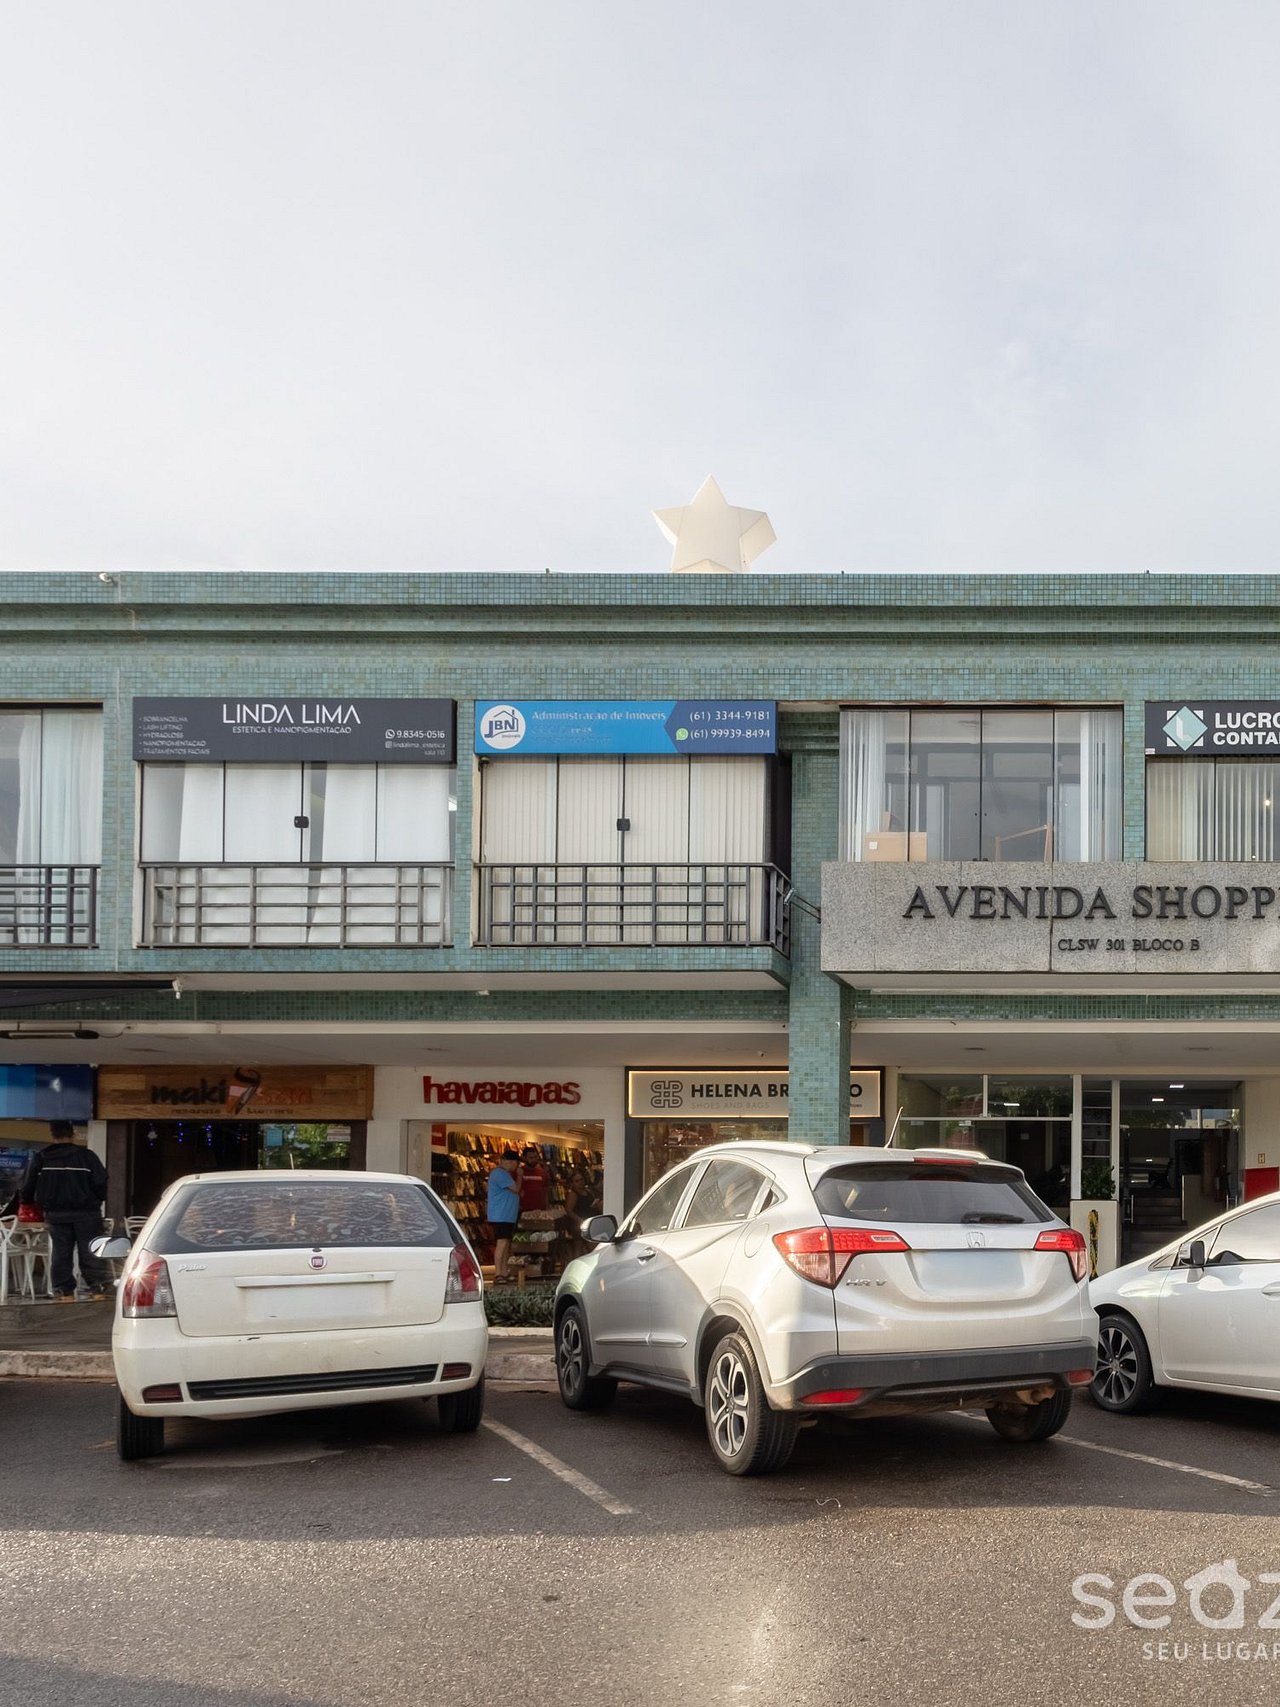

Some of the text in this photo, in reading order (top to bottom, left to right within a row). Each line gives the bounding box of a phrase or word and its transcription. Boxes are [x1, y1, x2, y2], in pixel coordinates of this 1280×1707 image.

[222, 703, 361, 724] LINDA LIMA
[610, 710, 624, 721] de
[689, 710, 771, 723] (61) 3344-9181
[485, 720, 517, 738] JBN
[690, 729, 770, 741] (61) 99939-8494
[902, 886, 1118, 920] AVENIDA
[1057, 937, 1200, 952] CLSW 301 BLOCO B
[422, 1076, 582, 1107] havaianas
[691, 1083, 762, 1098] HELENA
